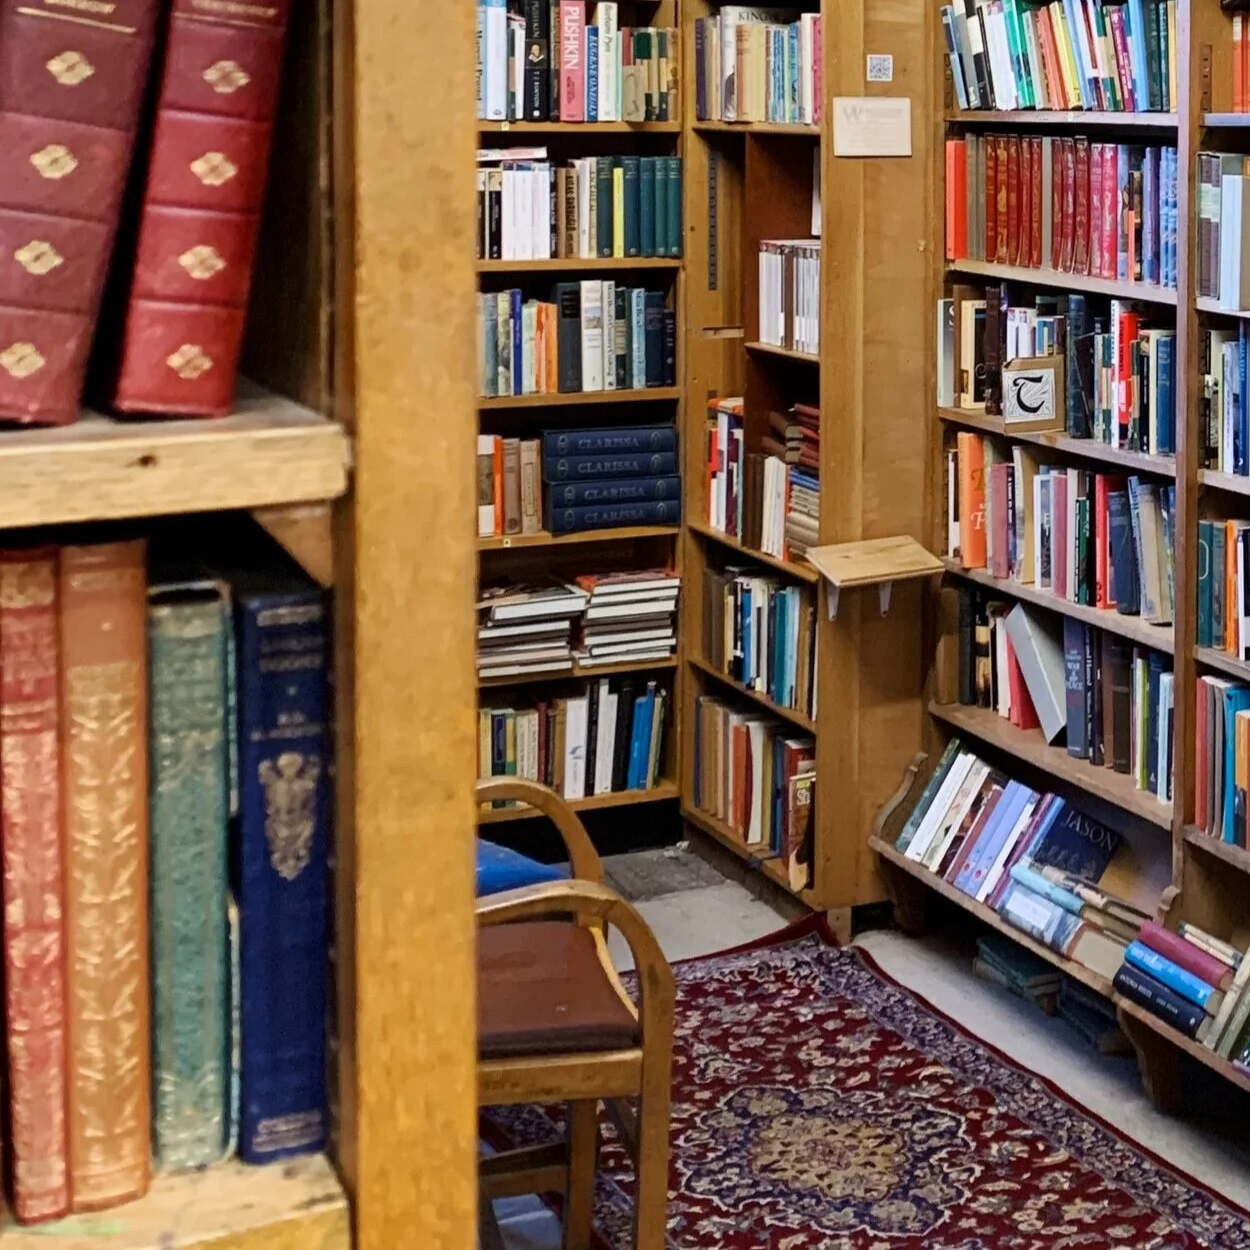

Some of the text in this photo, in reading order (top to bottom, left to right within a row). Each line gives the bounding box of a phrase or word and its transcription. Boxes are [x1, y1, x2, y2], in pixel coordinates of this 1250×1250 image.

[564, 6, 580, 70] PUSHKIN
[578, 438, 639, 449] CLARISSA
[578, 461, 638, 473] CLARISSA
[584, 487, 645, 500] CLARISSA
[584, 511, 645, 523] CLARISSA
[1066, 810, 1117, 851] JASON
